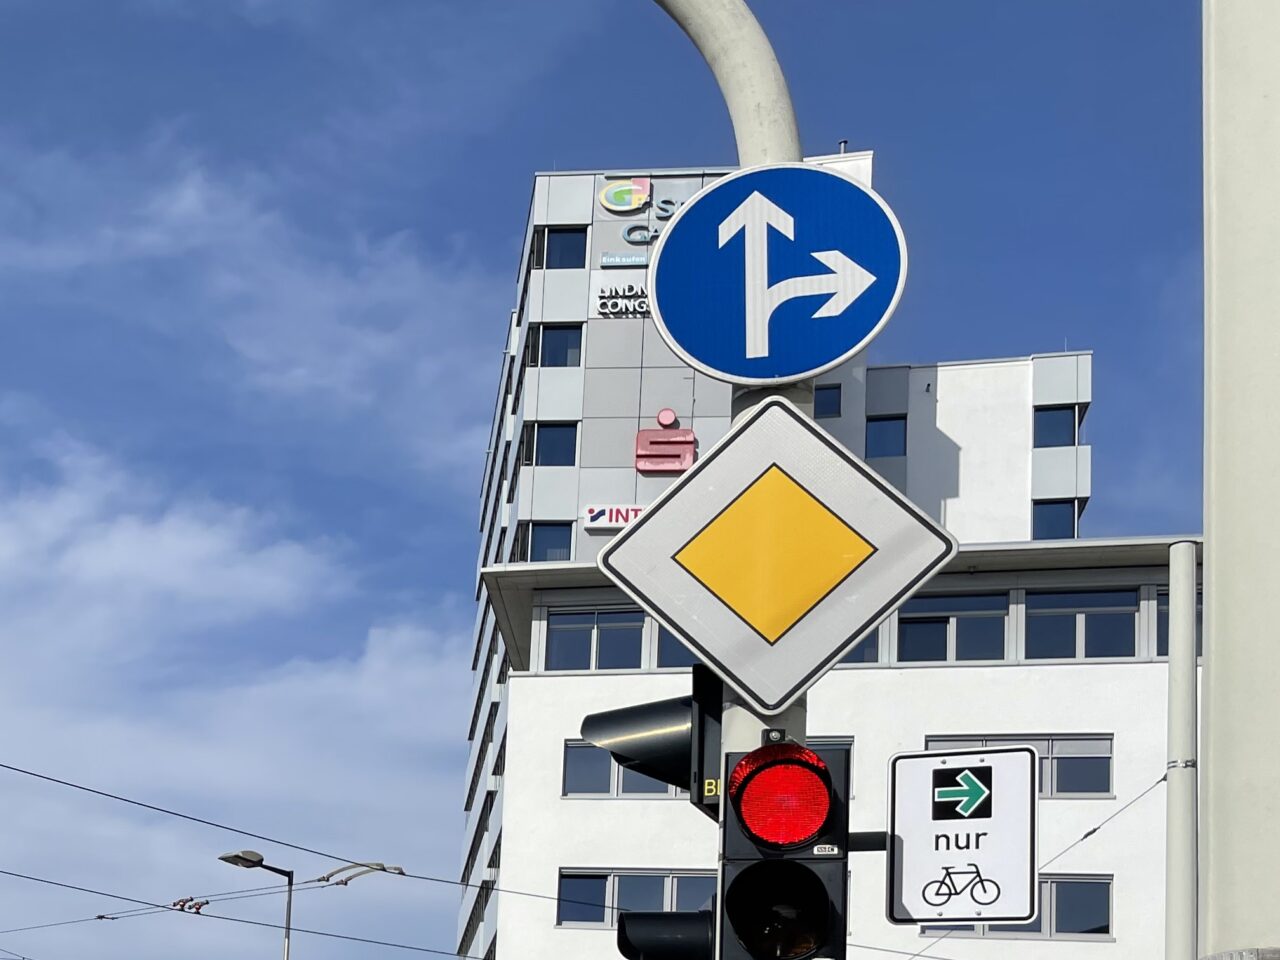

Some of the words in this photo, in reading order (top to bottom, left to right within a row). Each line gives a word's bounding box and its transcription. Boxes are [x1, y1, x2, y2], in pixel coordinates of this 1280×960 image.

[597, 298, 649, 314] CONG
[609, 507, 645, 523] INT
[934, 830, 988, 852] nur
